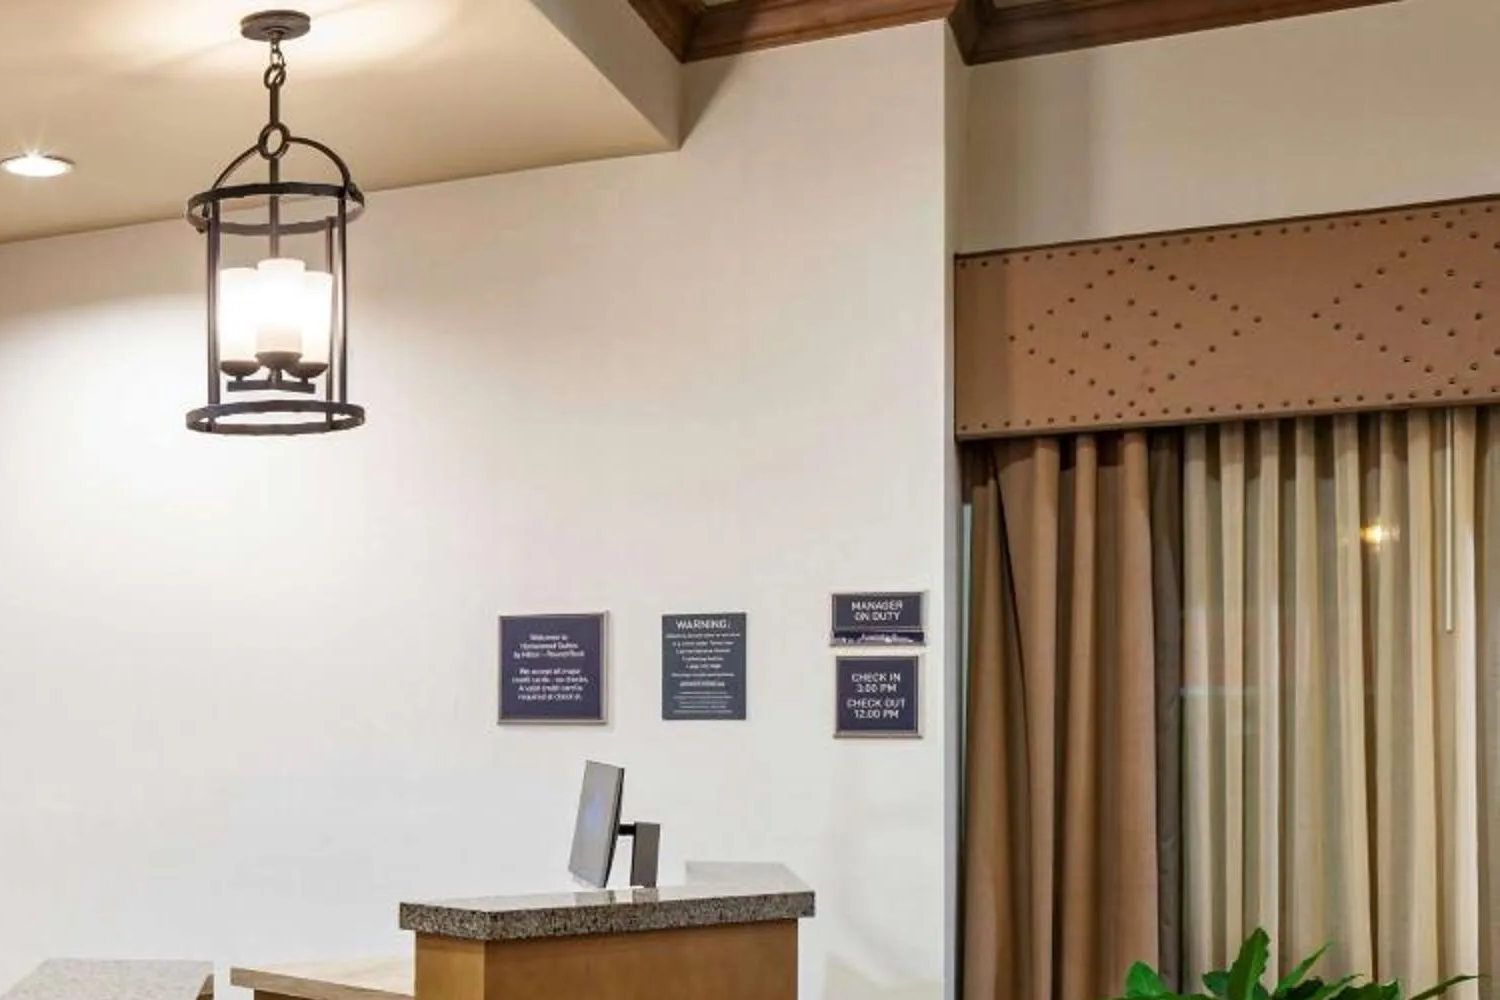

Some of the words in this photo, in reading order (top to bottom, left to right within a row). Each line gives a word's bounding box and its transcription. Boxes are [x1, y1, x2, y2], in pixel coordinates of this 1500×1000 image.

[851, 600, 902, 611] MANAGER
[853, 611, 869, 621] ON
[872, 611, 901, 621] DUTY
[851, 672, 887, 682] CHECK
[889, 672, 901, 682] IN
[880, 683, 897, 693] PM
[846, 698, 882, 708] CHECK
[885, 698, 906, 708] OUT
[883, 709, 899, 719] PM
